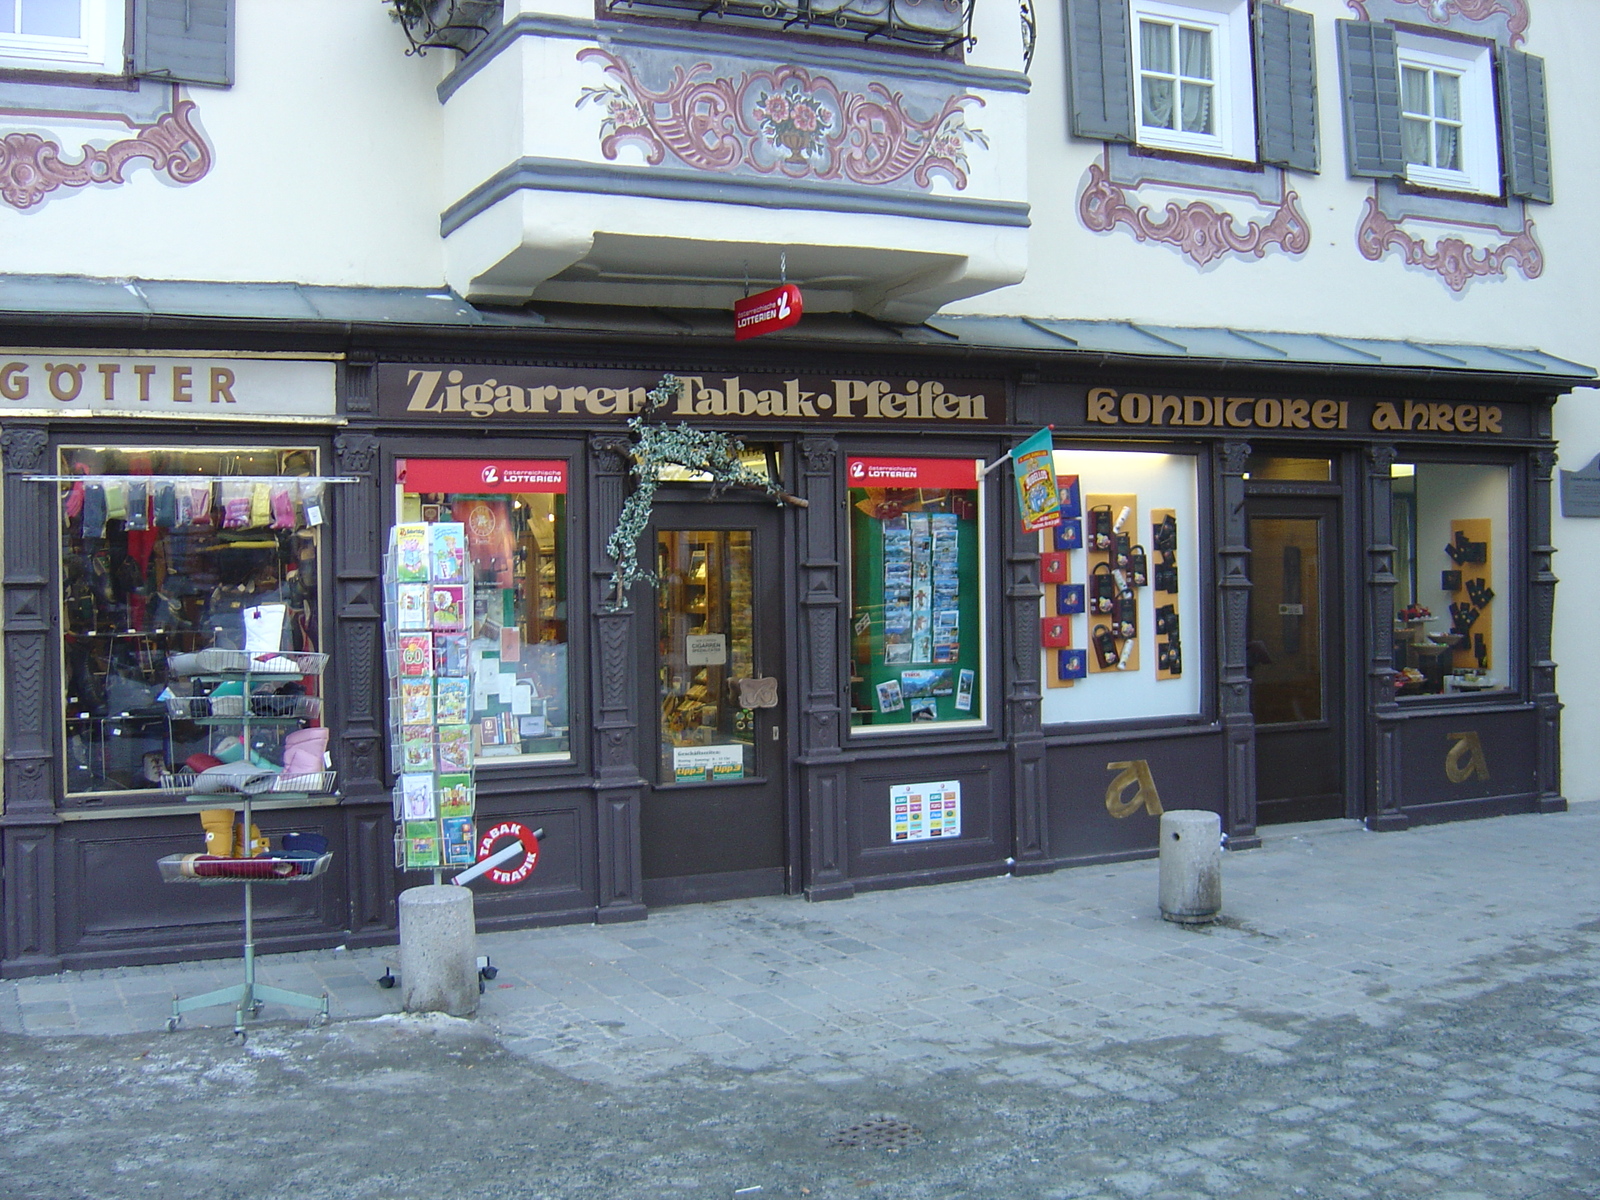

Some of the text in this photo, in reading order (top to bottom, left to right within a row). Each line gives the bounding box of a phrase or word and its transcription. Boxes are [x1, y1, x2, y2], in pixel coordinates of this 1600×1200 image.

[737, 309, 777, 328] LOTTERIEN
[0, 361, 237, 403] GÖTTER
[407, 370, 989, 420] Zigarren Tabak Pfeifen
[503, 475, 562, 483] LOTTERIEN
[403, 648, 424, 665] 60
[479, 823, 521, 856] TABAK
[493, 851, 537, 882] TRAFIK
